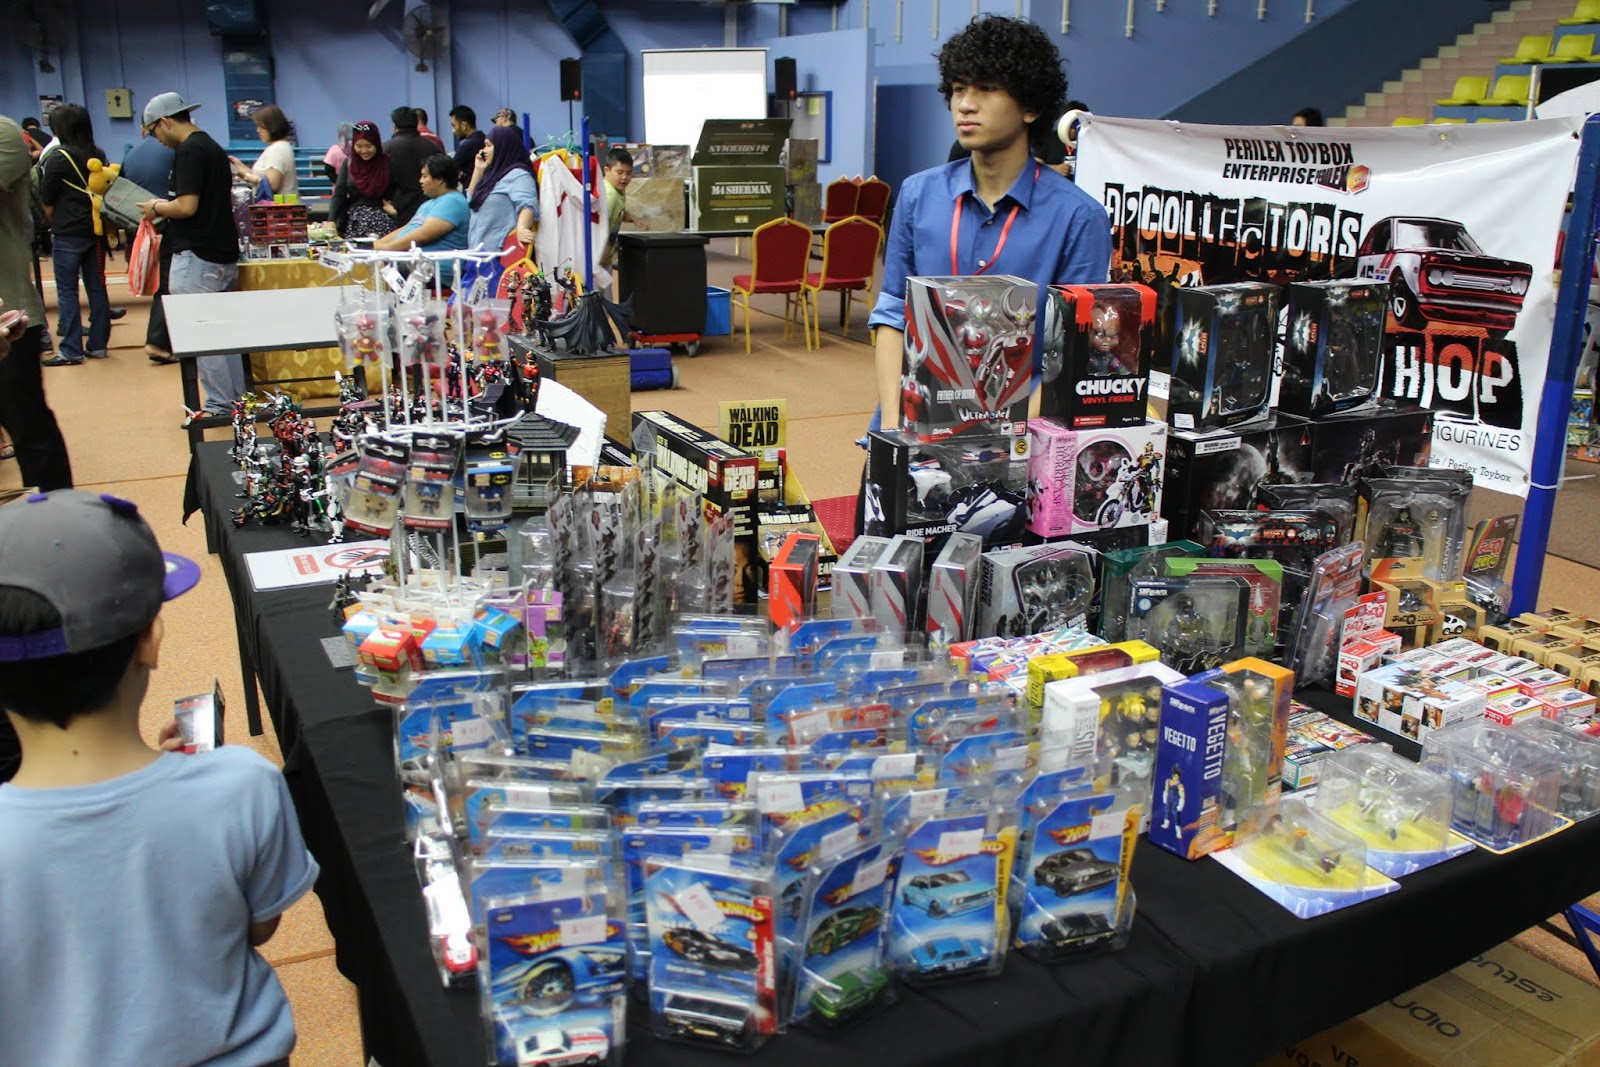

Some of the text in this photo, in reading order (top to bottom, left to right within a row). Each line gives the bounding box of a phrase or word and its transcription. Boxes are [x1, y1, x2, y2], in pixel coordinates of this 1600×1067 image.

[1224, 138, 1354, 165] PERILEX TOYBOX
[1222, 163, 1316, 185] ENTERPRISE
[711, 185, 772, 195] M4 SHERMAN
[1075, 377, 1146, 400] CHUCKY
[1082, 395, 1136, 404] VINYL FIGURE
[729, 406, 778, 423] WALKING
[729, 421, 778, 447] DEAD
[1053, 446, 1065, 508] HURRICANE
[1448, 460, 1477, 474] Perilex
[1479, 466, 1511, 482] Toybox
[724, 474, 755, 492] DEAD
[790, 513, 810, 523] DEAD
[906, 524, 957, 537] RIDE MACHER
[1163, 725, 1197, 752] VEGETTO
[1203, 711, 1227, 781] VEGETTO
